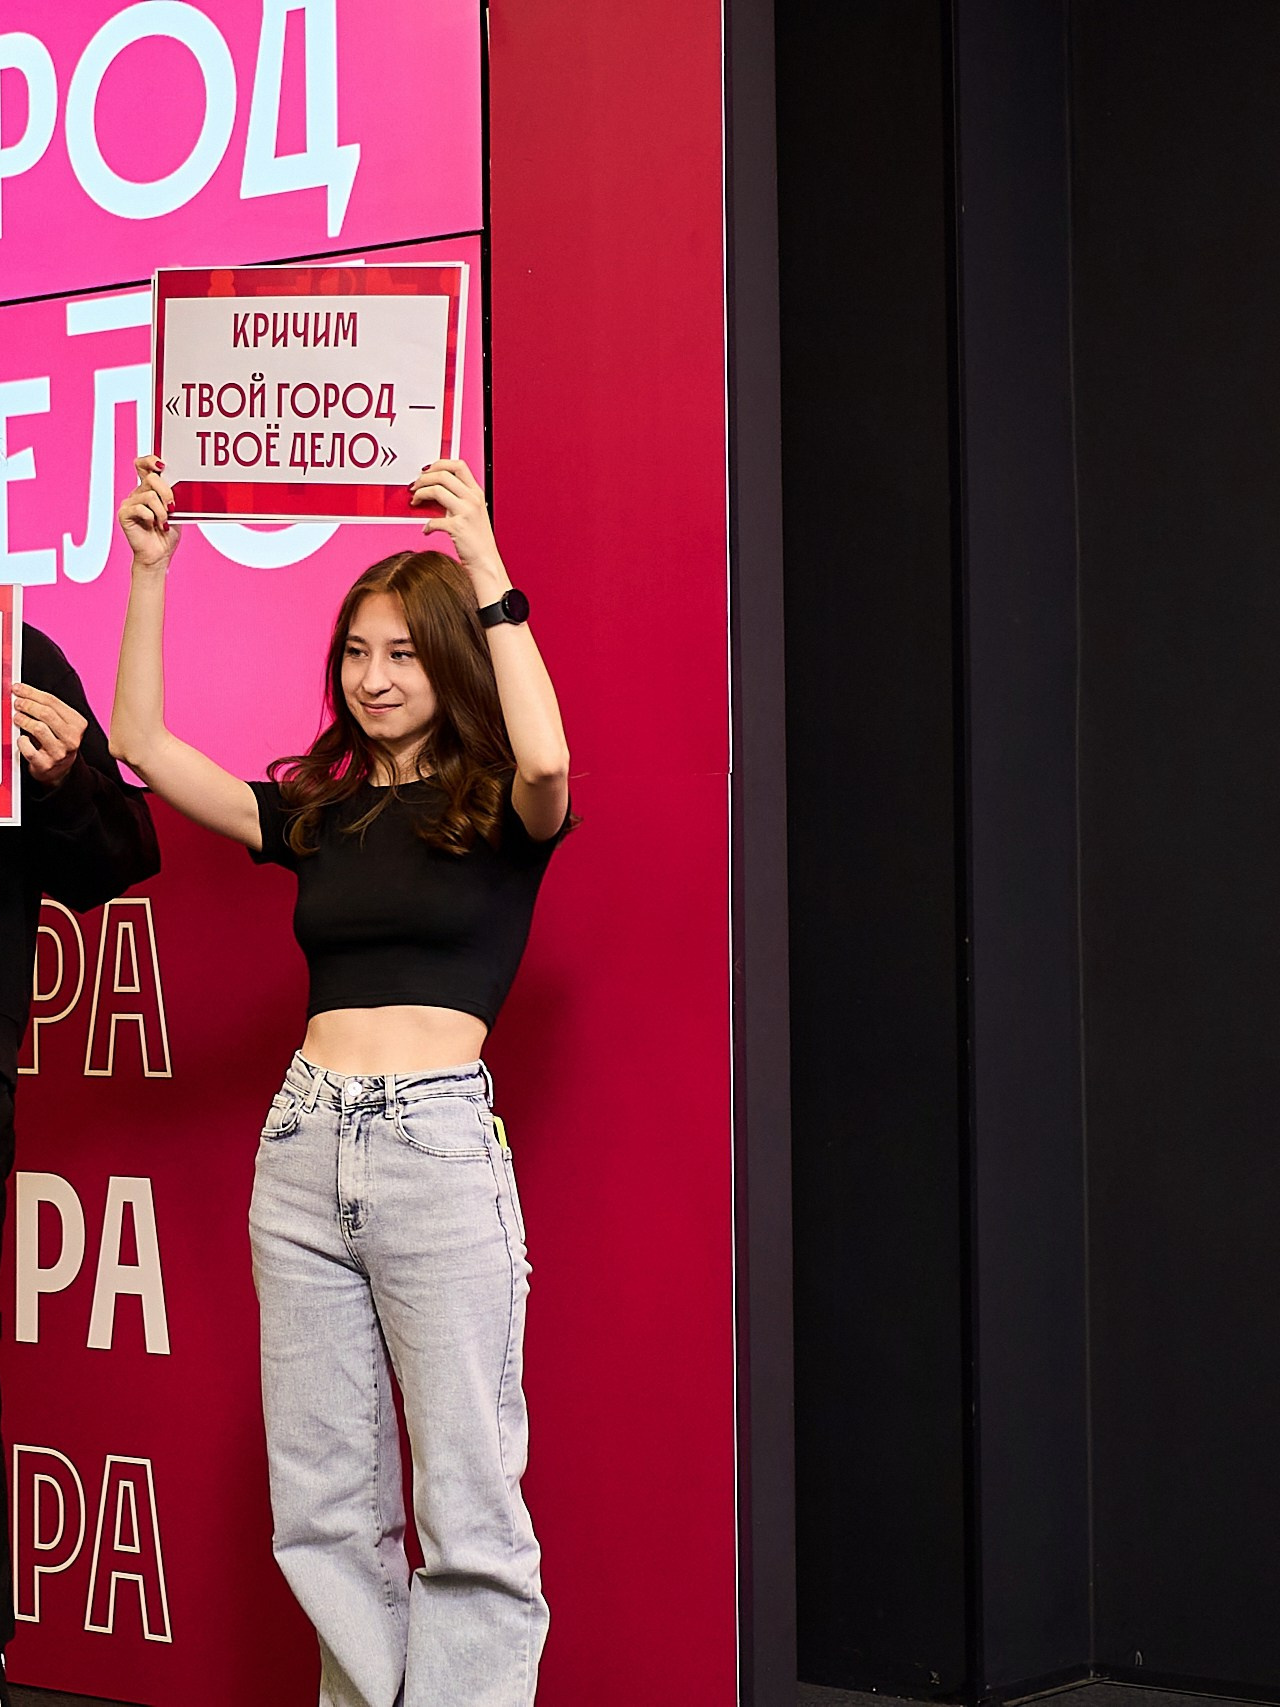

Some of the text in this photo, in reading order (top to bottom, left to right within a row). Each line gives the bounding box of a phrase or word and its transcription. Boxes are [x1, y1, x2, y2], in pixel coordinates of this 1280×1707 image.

[232, 312, 358, 348] КРИЧИМ
[165, 372, 267, 418] «ТВОЙ
[276, 382, 397, 427] ГОРОД
[196, 423, 398, 475] ТВОЁ ДЕЛО»
